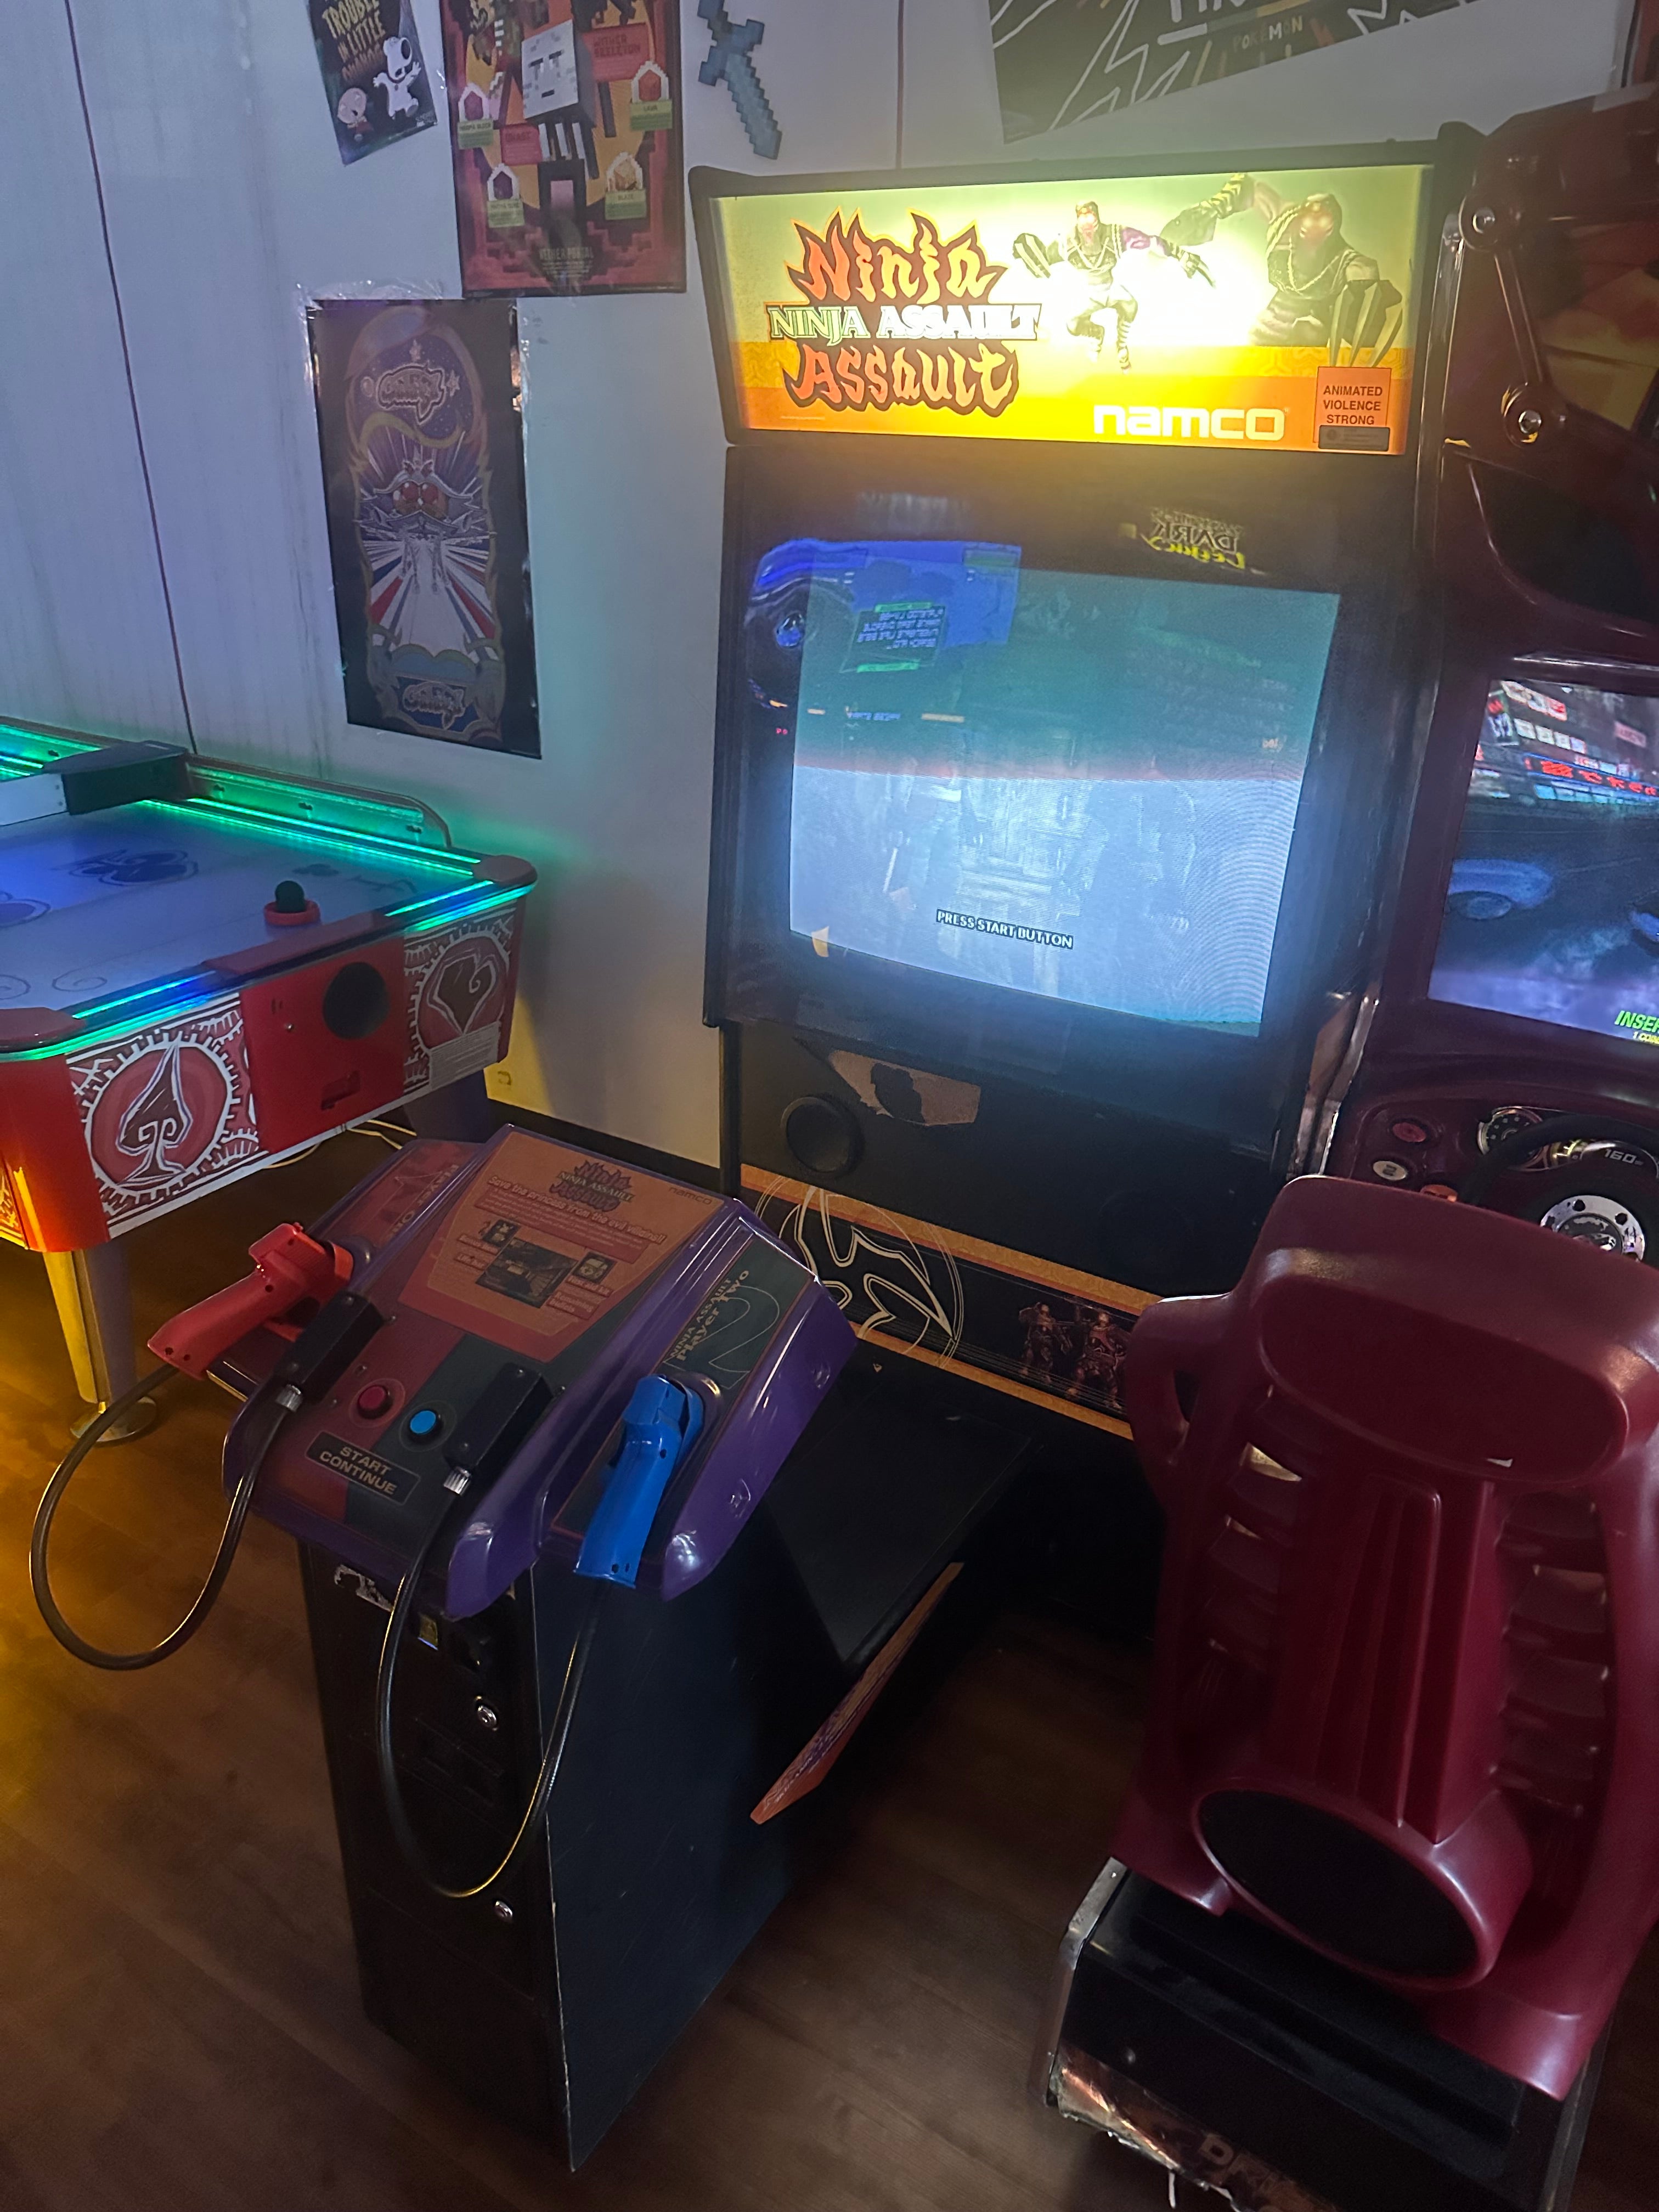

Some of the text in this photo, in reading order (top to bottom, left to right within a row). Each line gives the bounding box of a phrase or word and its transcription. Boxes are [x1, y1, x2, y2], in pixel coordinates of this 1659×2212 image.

[347, 9, 386, 55] LITTLE
[798, 223, 997, 304] Ninja
[770, 304, 1040, 347] NINJA ASSAULT
[1323, 385, 1383, 397] ANIMATED
[1323, 399, 1381, 411] VIOLENCE
[1094, 405, 1285, 441] namco
[1326, 414, 1375, 426] STRONG
[937, 910, 1073, 949] PRESS START BUTTON
[558, 1171, 633, 1201] NINJA ASSAULT
[668, 1186, 713, 1205] namco
[487, 1176, 510, 1190] Save
[512, 1183, 527, 1195] the
[527, 1188, 567, 1211] princess
[567, 1201, 591, 1218] from
[591, 1211, 608, 1224] the
[608, 1218, 626, 1231] evil
[670, 1327, 696, 1357] NINJA
[319, 1451, 398, 1496] CONTINUE
[340, 1446, 392, 1476] START
